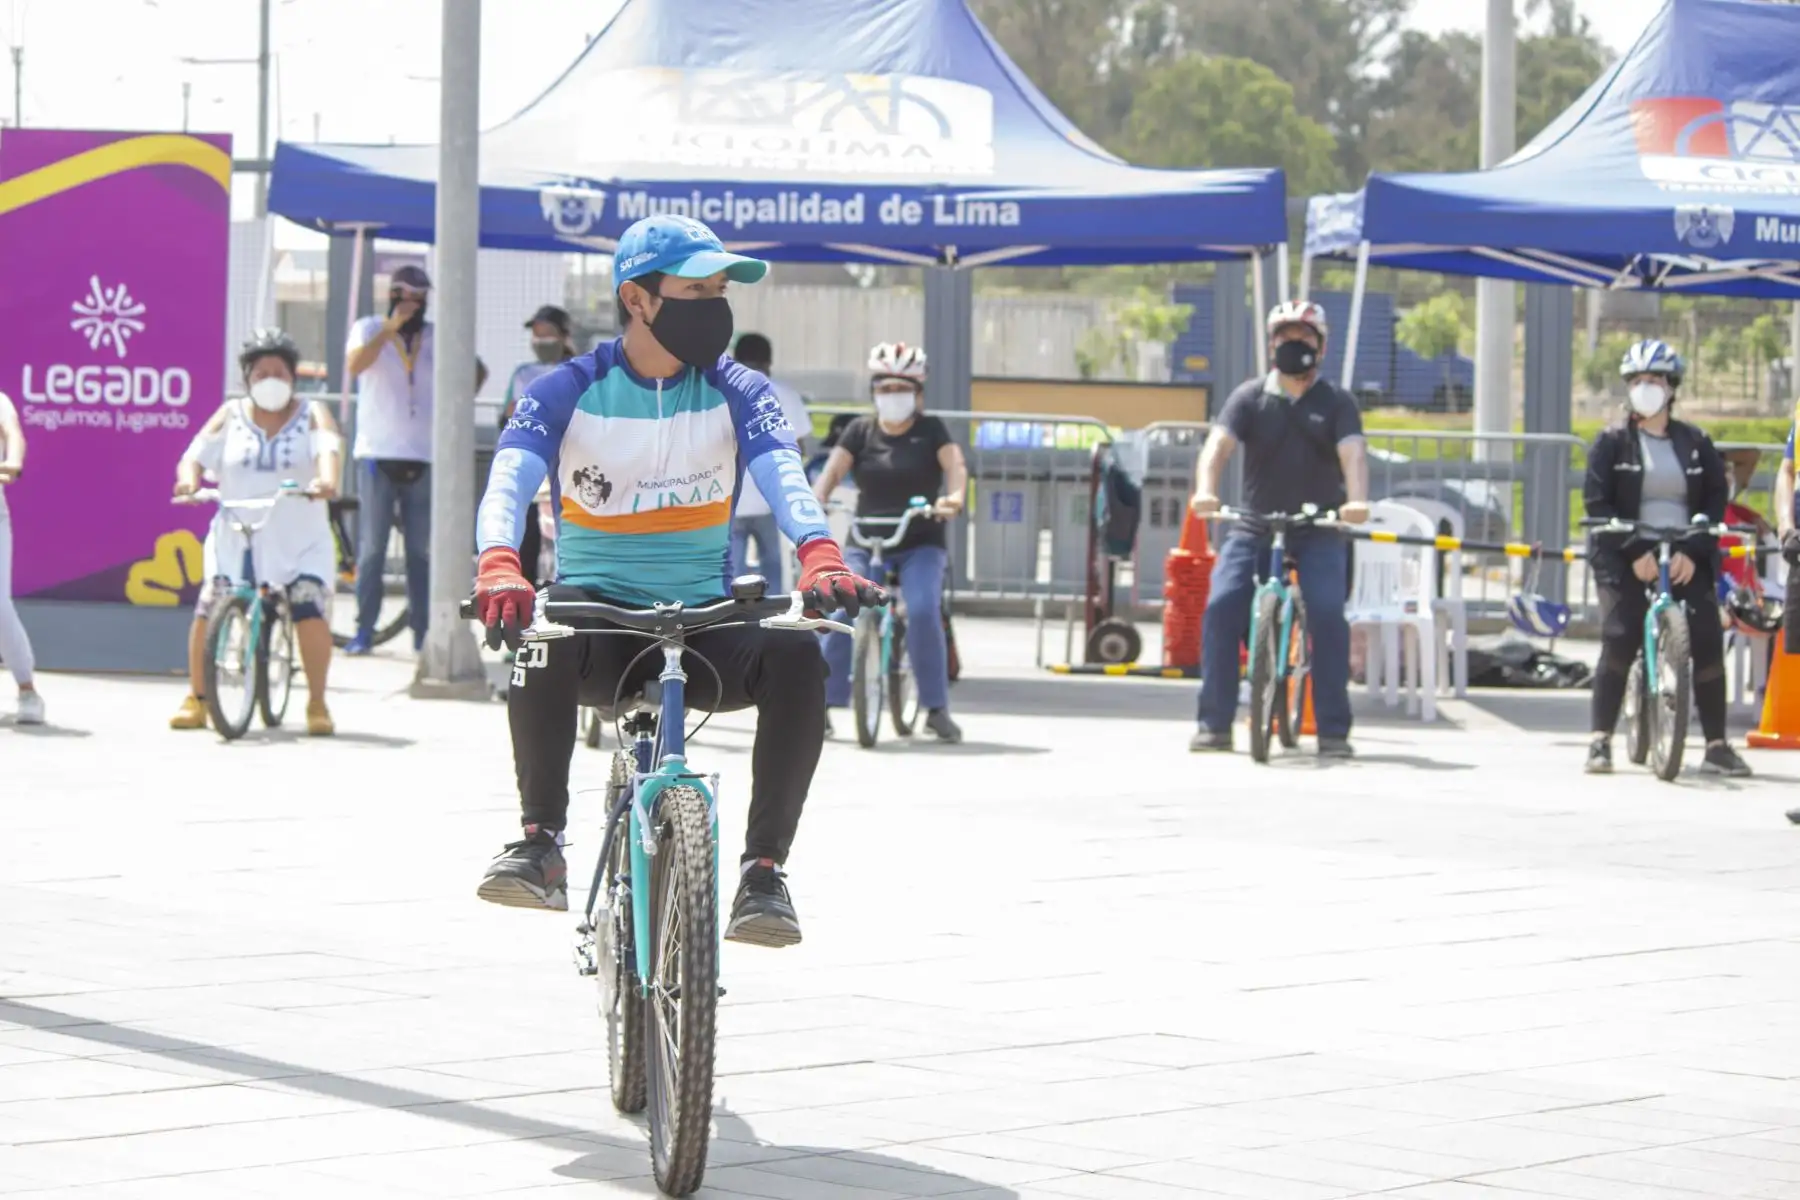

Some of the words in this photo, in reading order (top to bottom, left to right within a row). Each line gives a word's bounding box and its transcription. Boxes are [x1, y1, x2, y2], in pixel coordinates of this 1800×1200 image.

[617, 191, 864, 229] Municipalidad
[879, 193, 923, 226] de
[934, 194, 1020, 226] Lima
[23, 405, 112, 430] Seguimos
